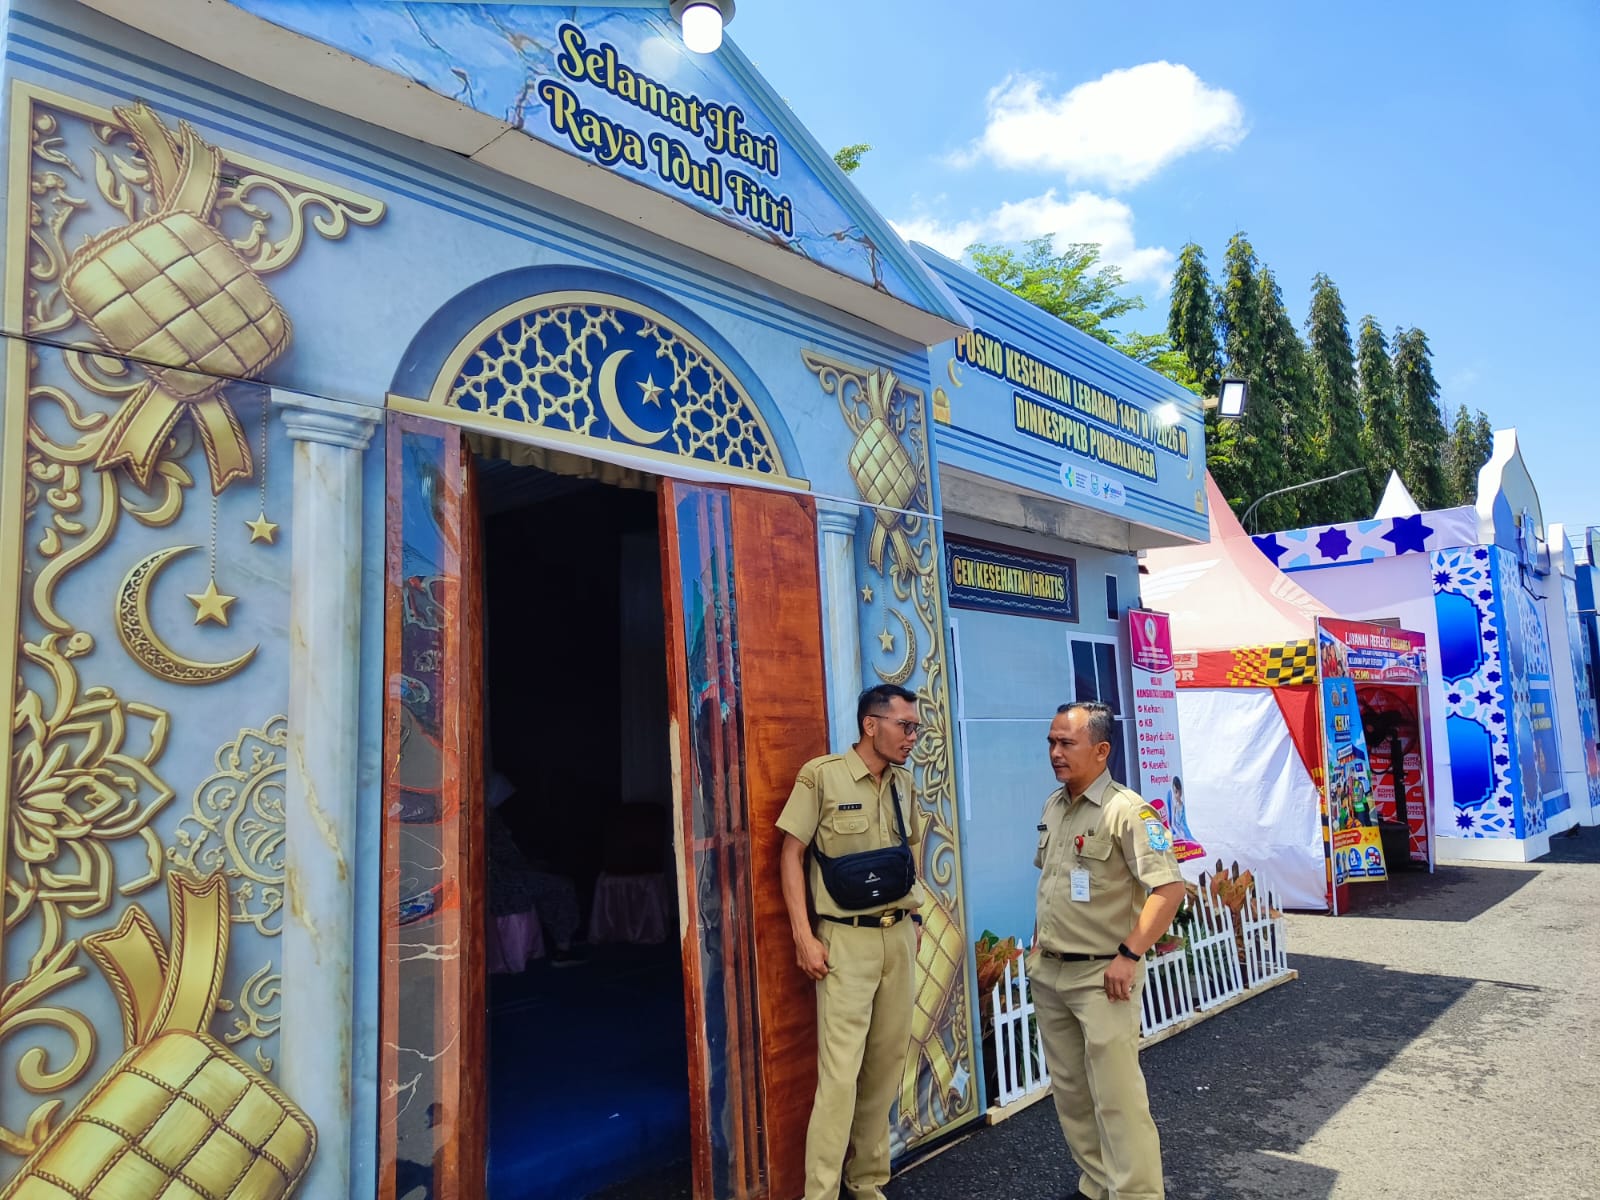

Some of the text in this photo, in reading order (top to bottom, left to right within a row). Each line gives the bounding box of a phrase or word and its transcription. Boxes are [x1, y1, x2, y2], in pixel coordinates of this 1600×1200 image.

[540, 80, 793, 237] Raya Idul Fitri
[558, 24, 779, 176] Selamat Hari
[957, 331, 1003, 375] POSKO
[1005, 345, 1072, 406] KESEHATAN
[1073, 378, 1118, 426] LEBARAN
[1119, 402, 1140, 436] 1447
[1141, 411, 1149, 440] H
[1156, 419, 1179, 452] 2026
[1179, 429, 1188, 457] M
[1015, 396, 1156, 480] DINKESPPKB PURBALINGGA
[953, 557, 1065, 601] CEK KESEHATAN GRATIS
